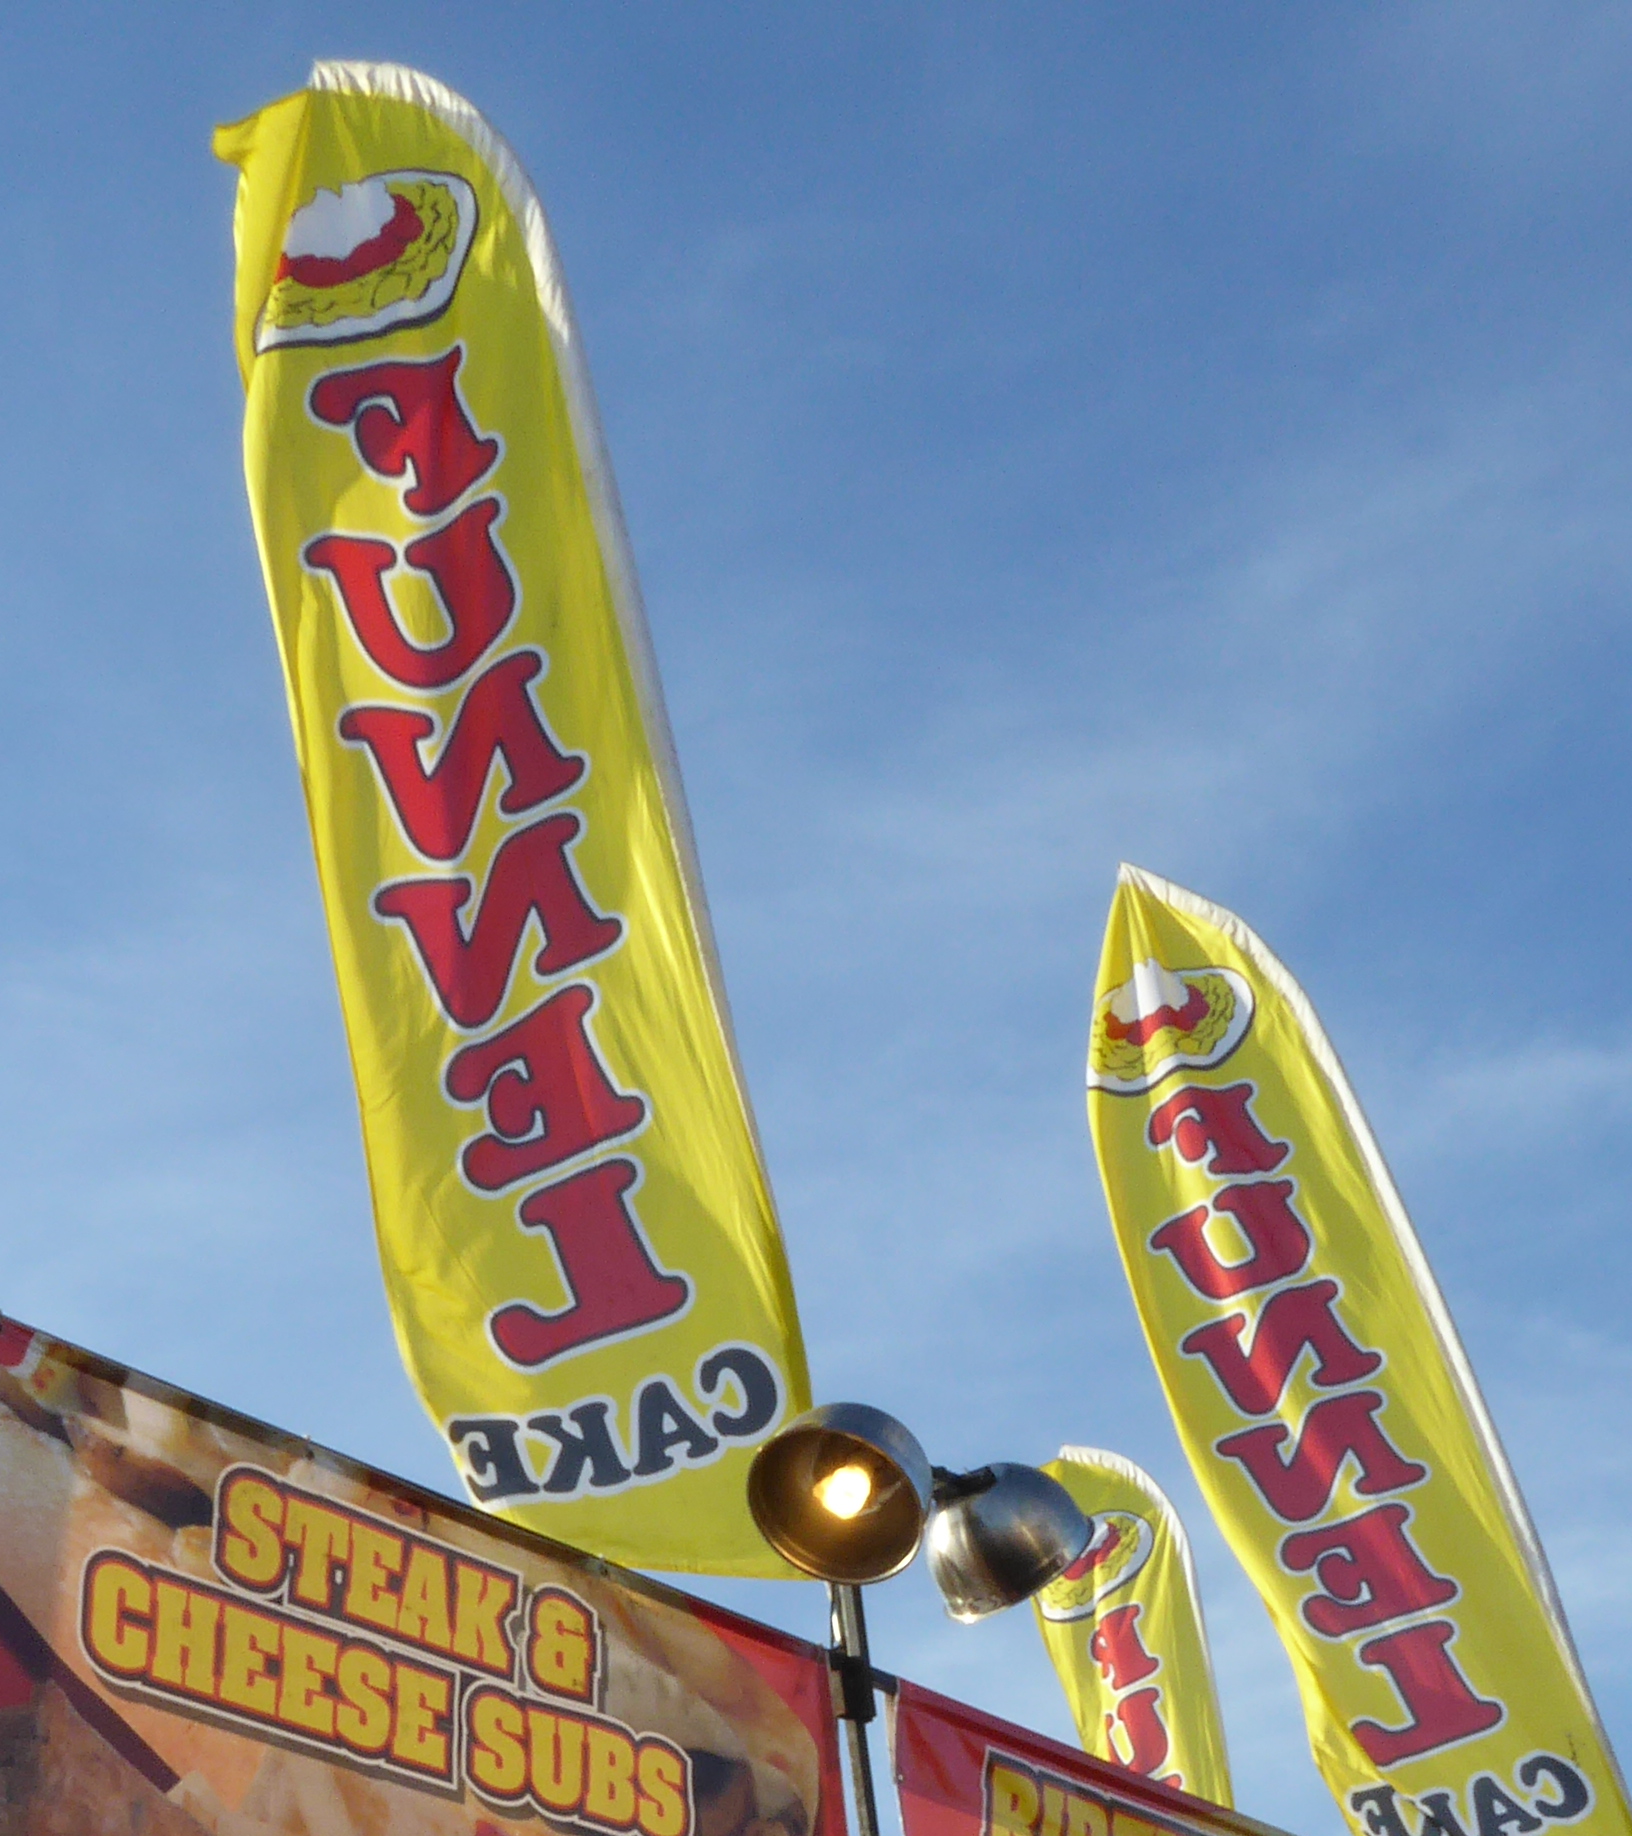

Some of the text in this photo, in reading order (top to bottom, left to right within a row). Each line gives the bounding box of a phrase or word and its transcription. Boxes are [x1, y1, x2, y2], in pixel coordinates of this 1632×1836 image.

[87, 1555, 458, 1781] CHEESE
[222, 1472, 594, 1700] STEAK &
